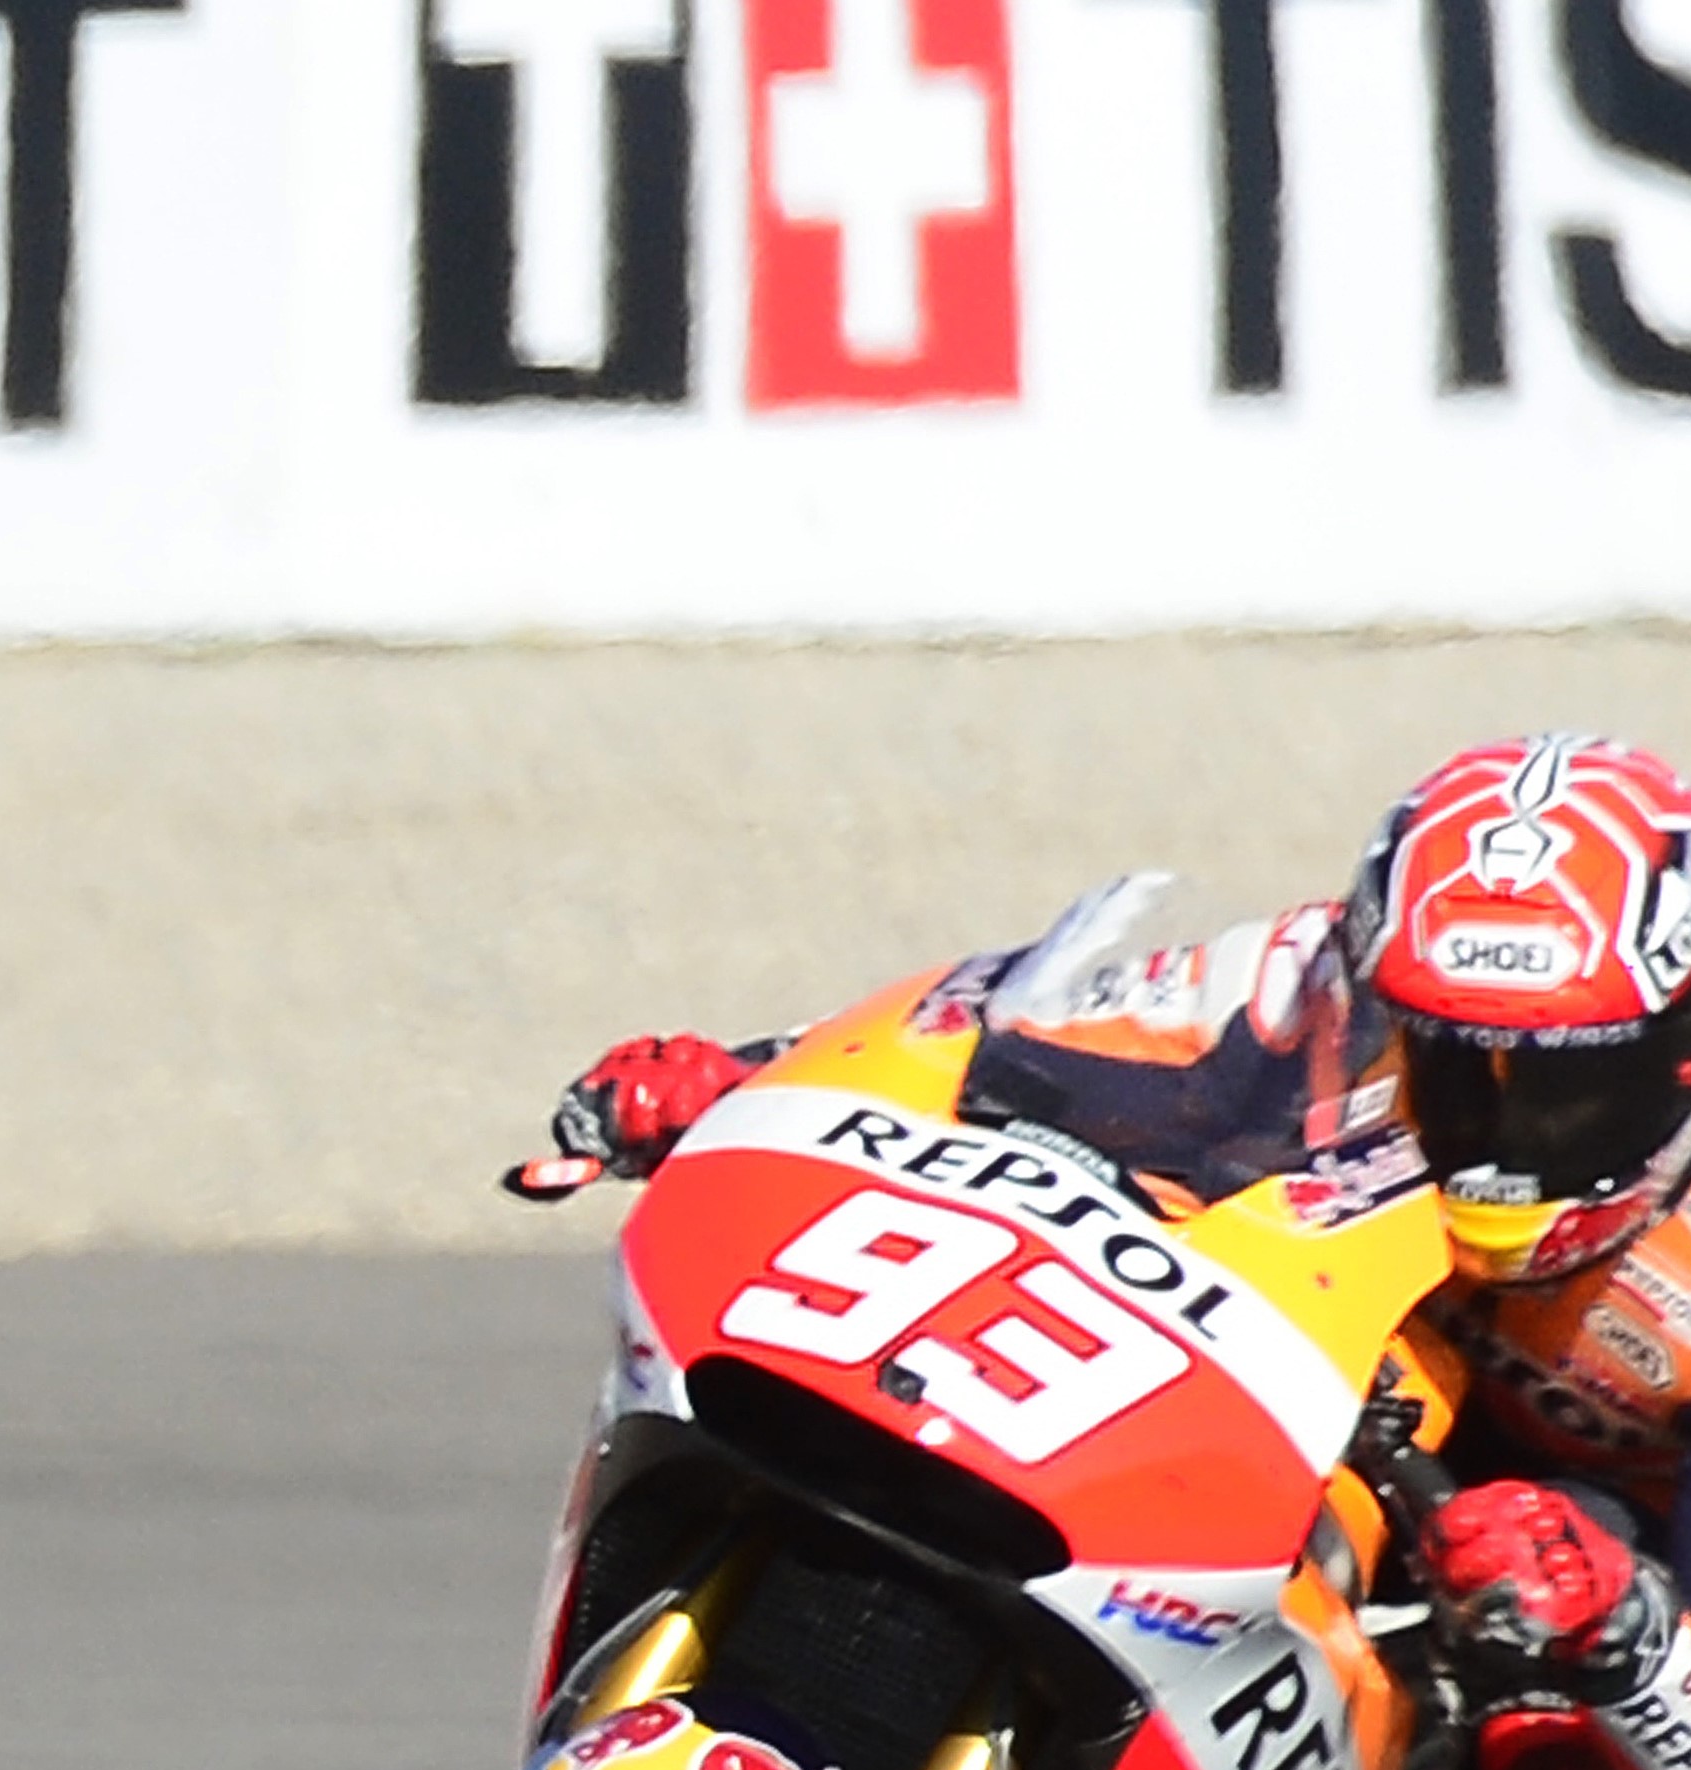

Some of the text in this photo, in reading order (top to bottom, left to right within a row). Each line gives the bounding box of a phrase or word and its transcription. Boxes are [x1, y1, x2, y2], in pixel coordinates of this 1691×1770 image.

[1445, 938, 1554, 975] SHOEI
[818, 1109, 1221, 1342] REPSOL
[719, 1188, 1192, 1464] 93
[1098, 1580, 1238, 1647] HRC
